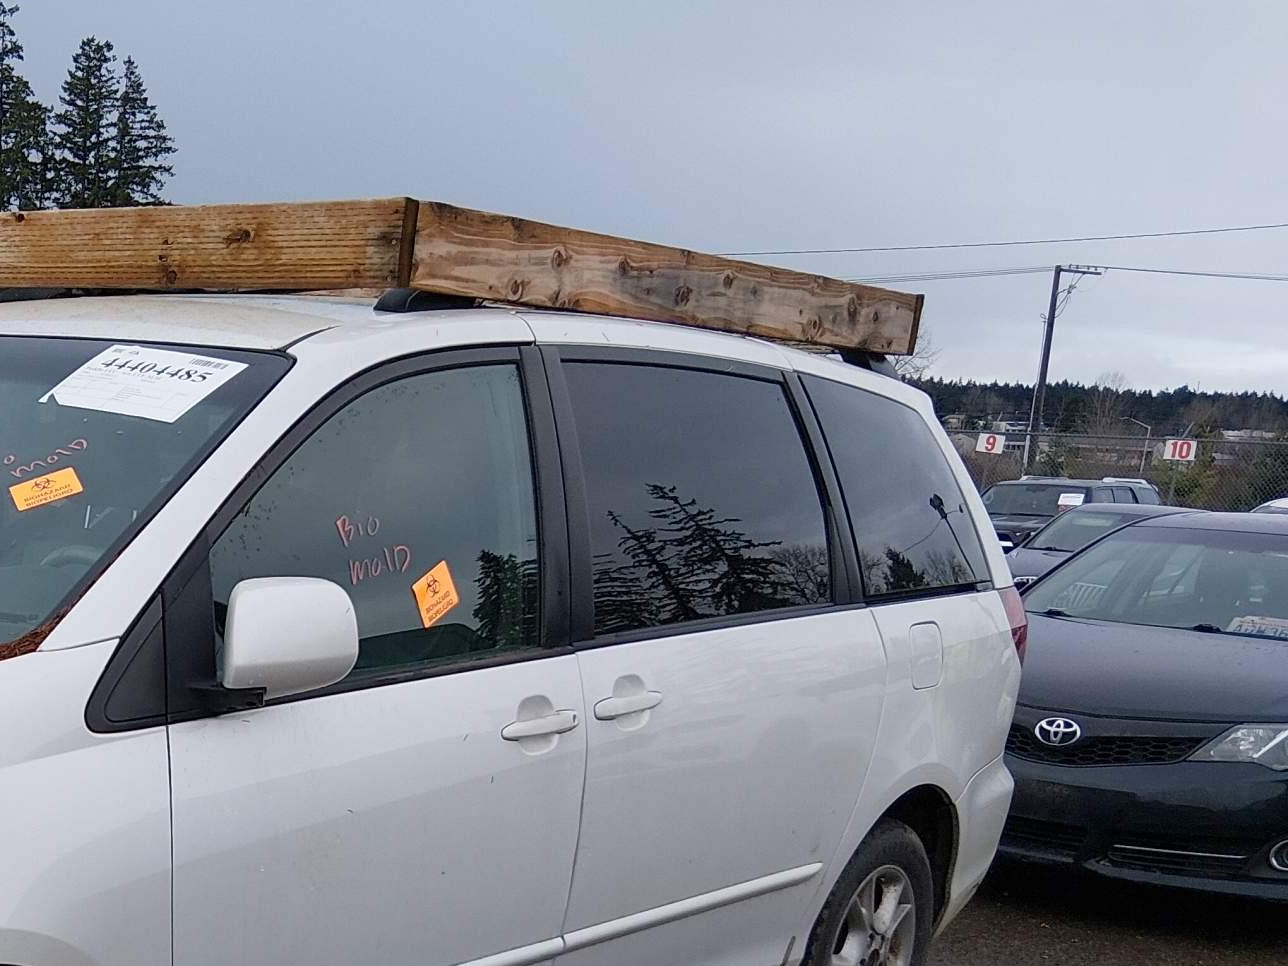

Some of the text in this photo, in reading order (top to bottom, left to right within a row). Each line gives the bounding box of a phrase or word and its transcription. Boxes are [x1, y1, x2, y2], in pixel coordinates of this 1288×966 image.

[101, 357, 213, 383] 44404485
[984, 435, 997, 451] 9
[1171, 441, 1192, 459] 10
